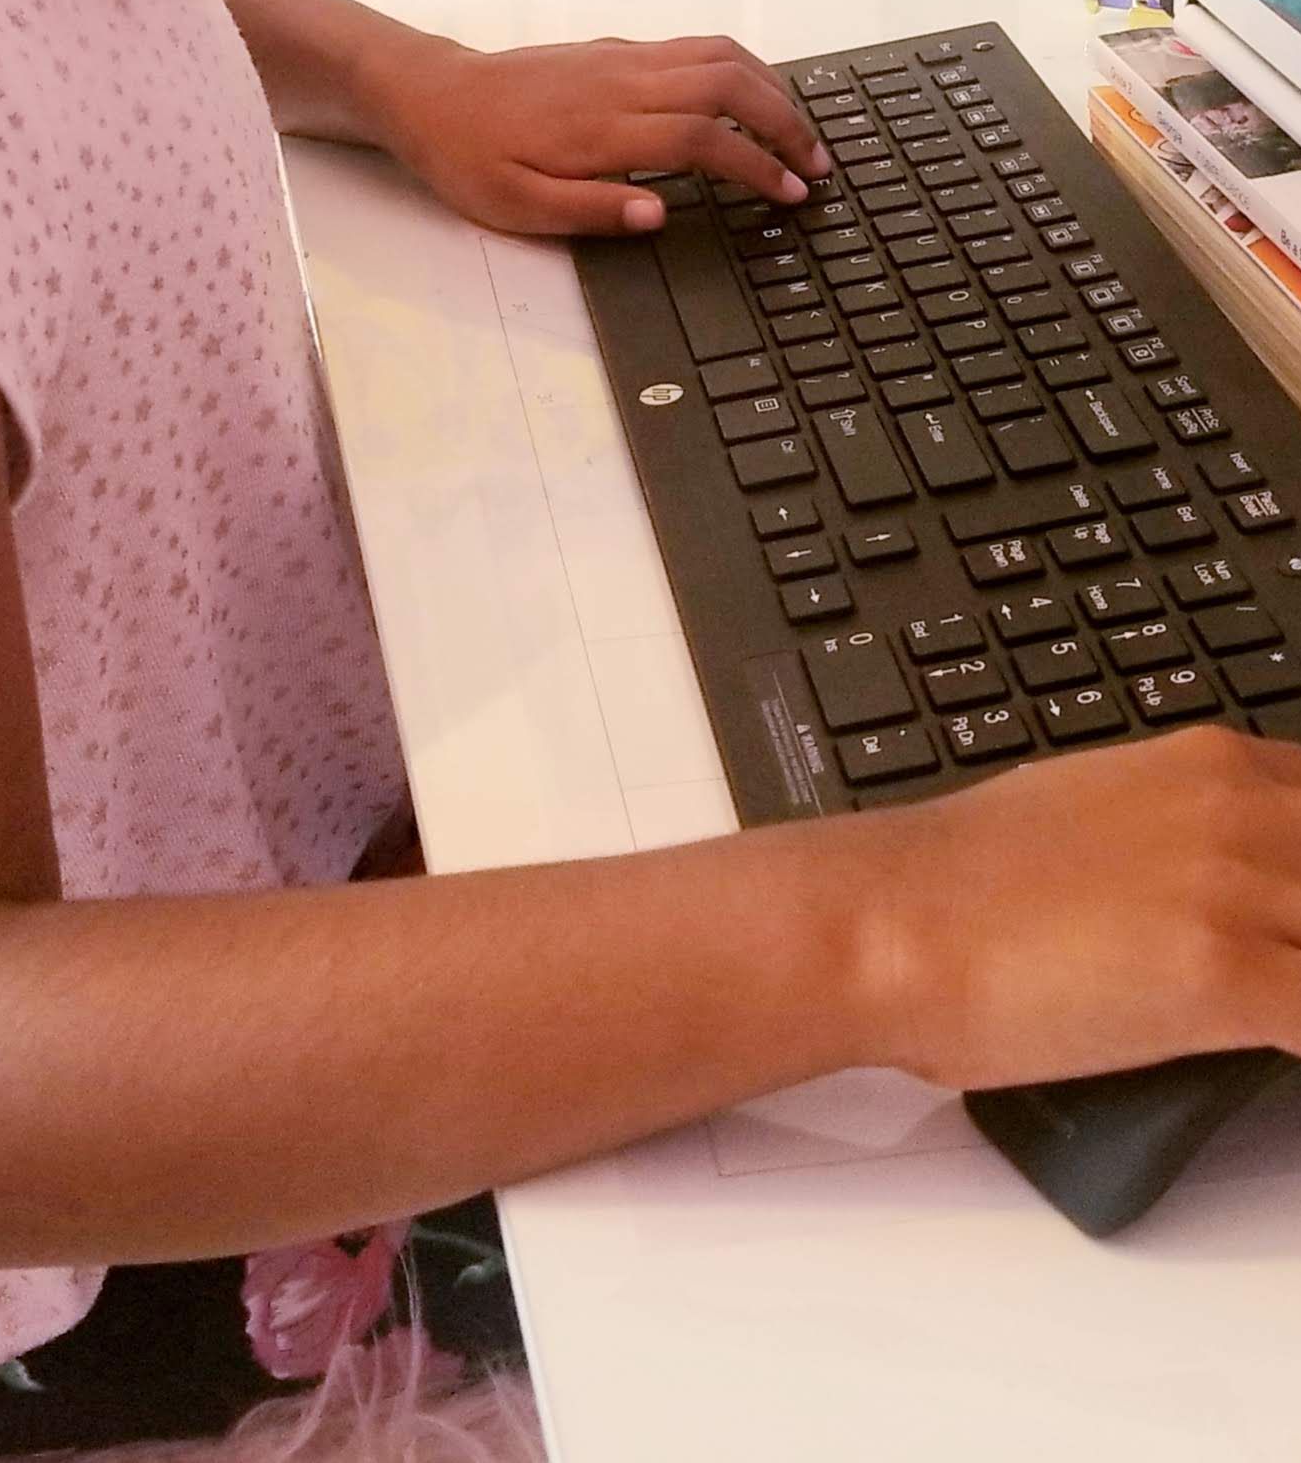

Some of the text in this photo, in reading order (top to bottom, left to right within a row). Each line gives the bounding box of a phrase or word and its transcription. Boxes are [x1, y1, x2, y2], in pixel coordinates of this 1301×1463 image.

[860, 136, 879, 146] E
[873, 160, 892, 170] R
[812, 178, 830, 187] F
[888, 184, 907, 192] T
[823, 202, 844, 214] G
[902, 209, 921, 218] Y
[763, 227, 782, 238] B
[836, 228, 856, 238] H
[916, 235, 936, 245] U
[775, 254, 795, 265] N
[989, 267, 1004, 275] 9
[787, 281, 809, 293] M
[865, 282, 886, 293] K
[880, 311, 899, 322] L
[965, 319, 987, 330] P
[1157, 378, 1177, 398] Lock
[1174, 374, 1198, 396] Scroll
[1228, 451, 1253, 474] Insert
[1151, 465, 1173, 491] Home
[1069, 484, 1090, 509] Delete
[1258, 490, 1283, 516] Pause
[1239, 494, 1264, 519] Break
[1176, 505, 1198, 523] End
[1072, 526, 1090, 540] Up
[1092, 522, 1112, 545] Page
[988, 543, 1009, 569] Down
[1006, 539, 1027, 562] Page
[1192, 564, 1217, 586] Lock
[1211, 559, 1233, 581] Num
[1115, 577, 1142, 588] 7
[1029, 597, 1053, 609] 4
[1086, 585, 1109, 610] Home
[939, 614, 964, 625] 1
[910, 620, 931, 640] End
[1142, 623, 1167, 636] 8
[849, 632, 874, 645] 0
[1051, 641, 1077, 655] 5
[959, 660, 986, 674] 2
[1169, 670, 1196, 685] 9
[1076, 690, 1103, 705] 6
[1138, 676, 1164, 707] Pg Up
[983, 710, 1010, 724] 3
[952, 716, 976, 747] Pg Dn
[861, 735, 882, 755] Del
